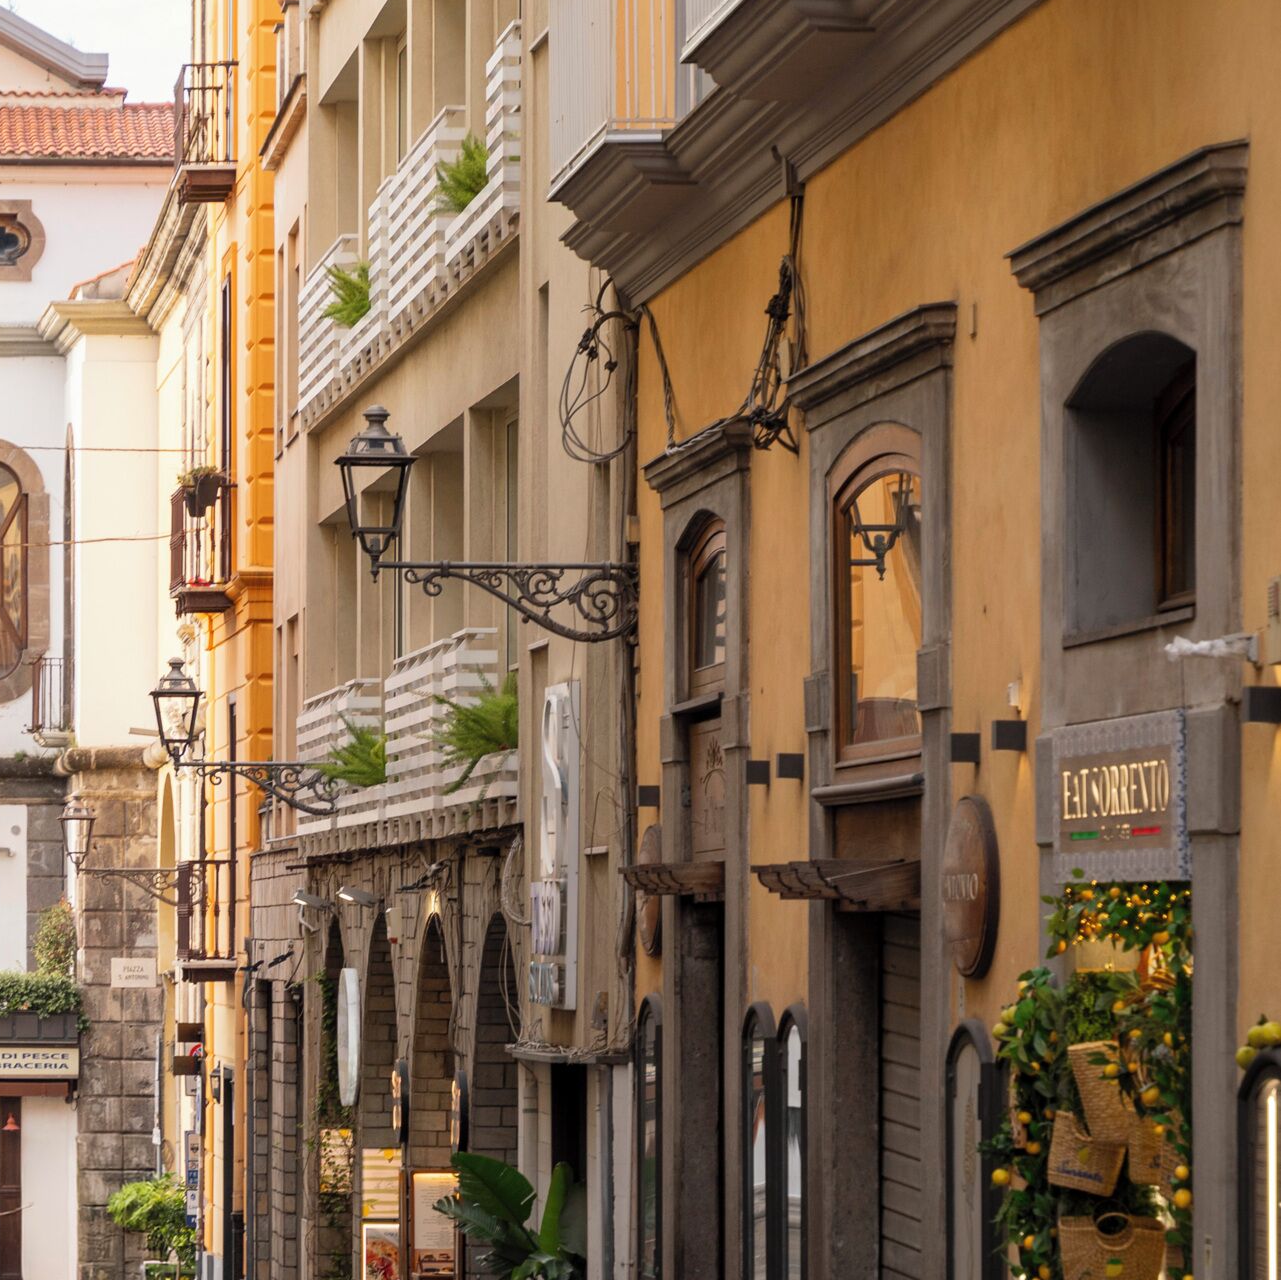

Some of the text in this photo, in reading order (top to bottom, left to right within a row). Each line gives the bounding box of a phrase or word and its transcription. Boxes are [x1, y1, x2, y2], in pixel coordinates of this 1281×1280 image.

[1062, 759, 1170, 820] EAT SORRENTO
[122, 966, 144, 974] PIAZZA
[1, 1052, 18, 1061] DI
[21, 1052, 70, 1061] PESCE
